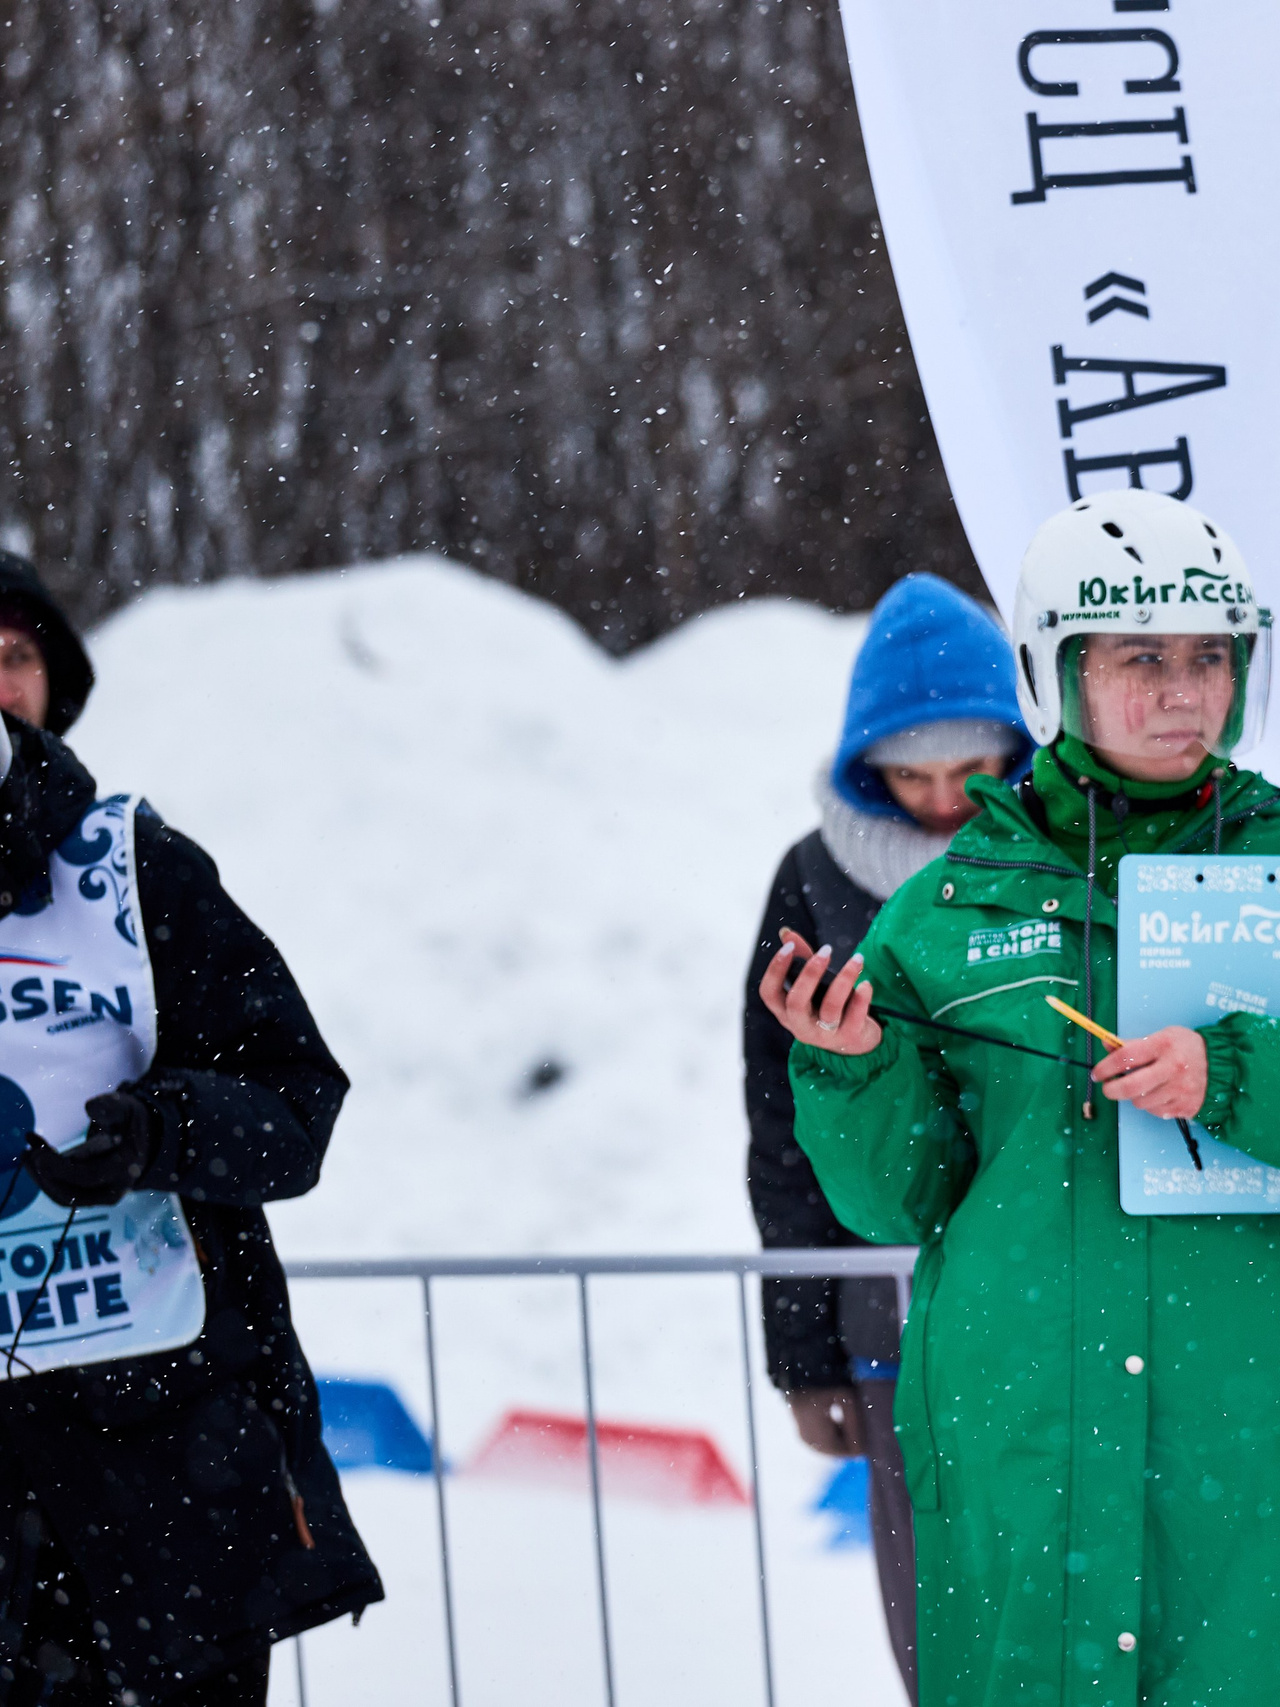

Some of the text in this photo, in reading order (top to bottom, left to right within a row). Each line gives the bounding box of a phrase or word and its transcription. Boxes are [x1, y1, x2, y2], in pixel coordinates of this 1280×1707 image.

[1011, 0, 1197, 206] СЦ
[1060, 610, 1121, 623] МУРМАНСК
[1008, 922, 1061, 941] ТОЛК
[967, 947, 982, 962] В
[986, 934, 1062, 957] СНЕГЕ
[1148, 959, 1191, 969] РОССИИ
[0, 976, 133, 1026] SEN
[1205, 993, 1217, 1007] В
[0, 1230, 120, 1284] ОЛК
